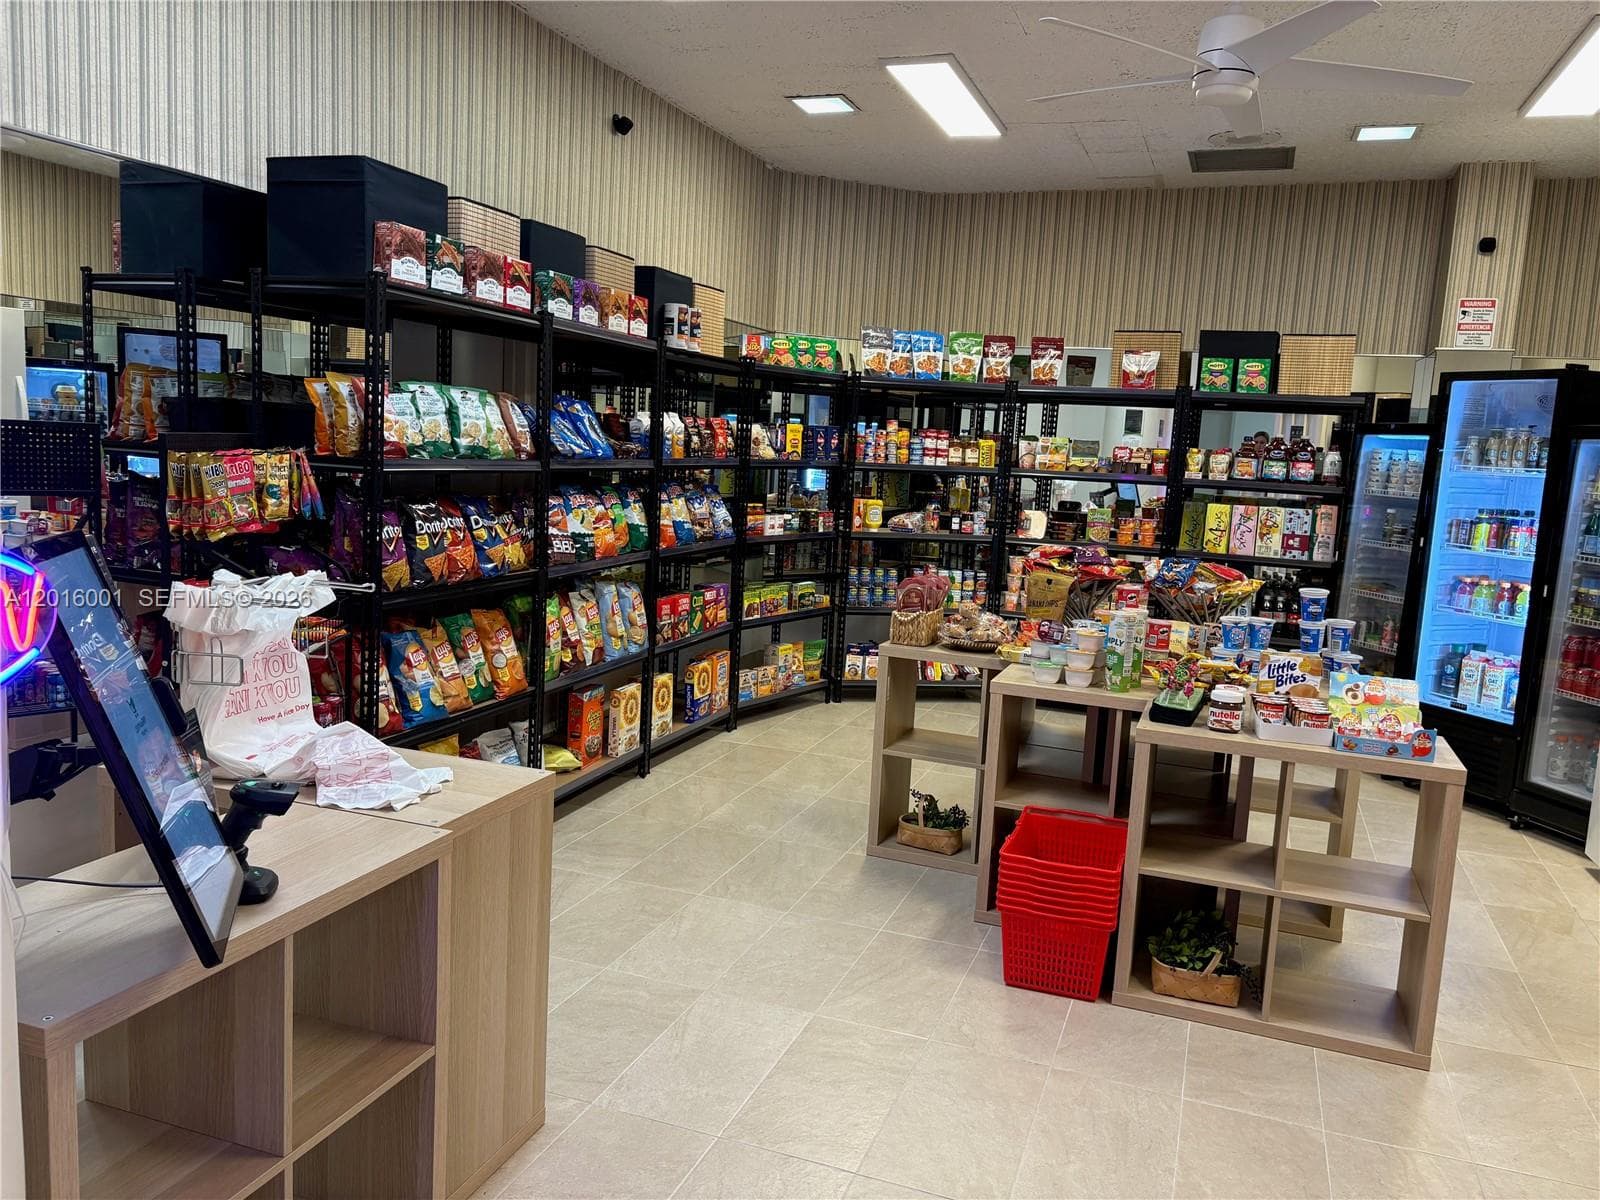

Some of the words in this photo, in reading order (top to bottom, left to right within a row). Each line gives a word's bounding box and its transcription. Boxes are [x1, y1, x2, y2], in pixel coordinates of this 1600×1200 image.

[1268, 660, 1297, 679] Little
[1276, 673, 1307, 688] Bites
[295, 703, 310, 712] Day
[1209, 711, 1240, 720] nutella
[1259, 711, 1283, 720] nutella
[1303, 720, 1328, 729] nutella
